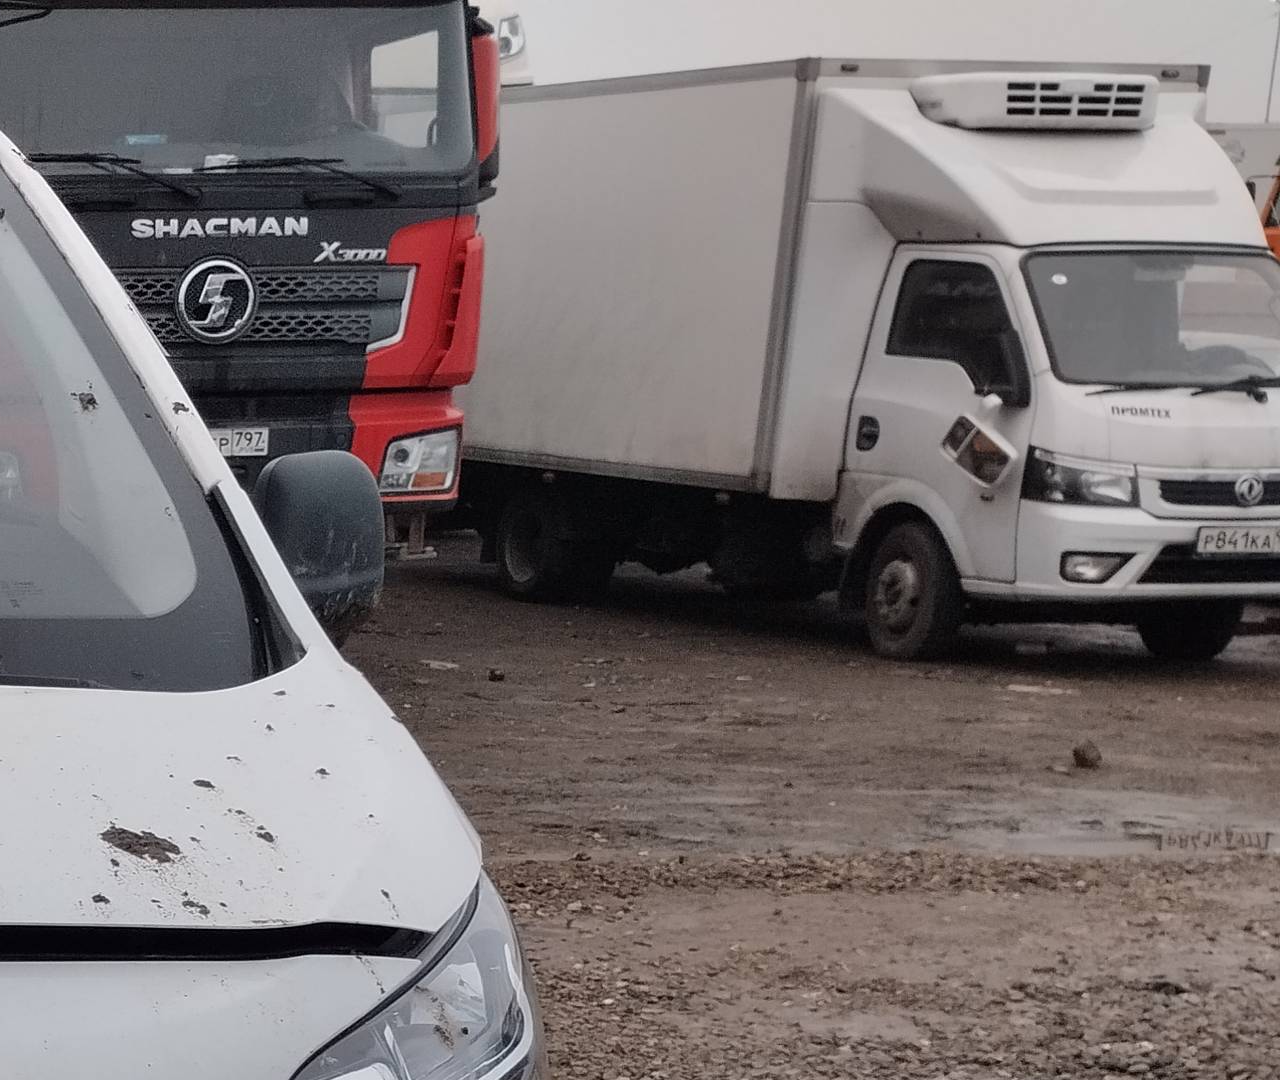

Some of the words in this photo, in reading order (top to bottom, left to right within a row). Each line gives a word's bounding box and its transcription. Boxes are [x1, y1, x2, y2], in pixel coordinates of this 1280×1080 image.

[130, 216, 309, 239] SHACMAN
[313, 241, 387, 263] X3000
[235, 431, 264, 448] 797
